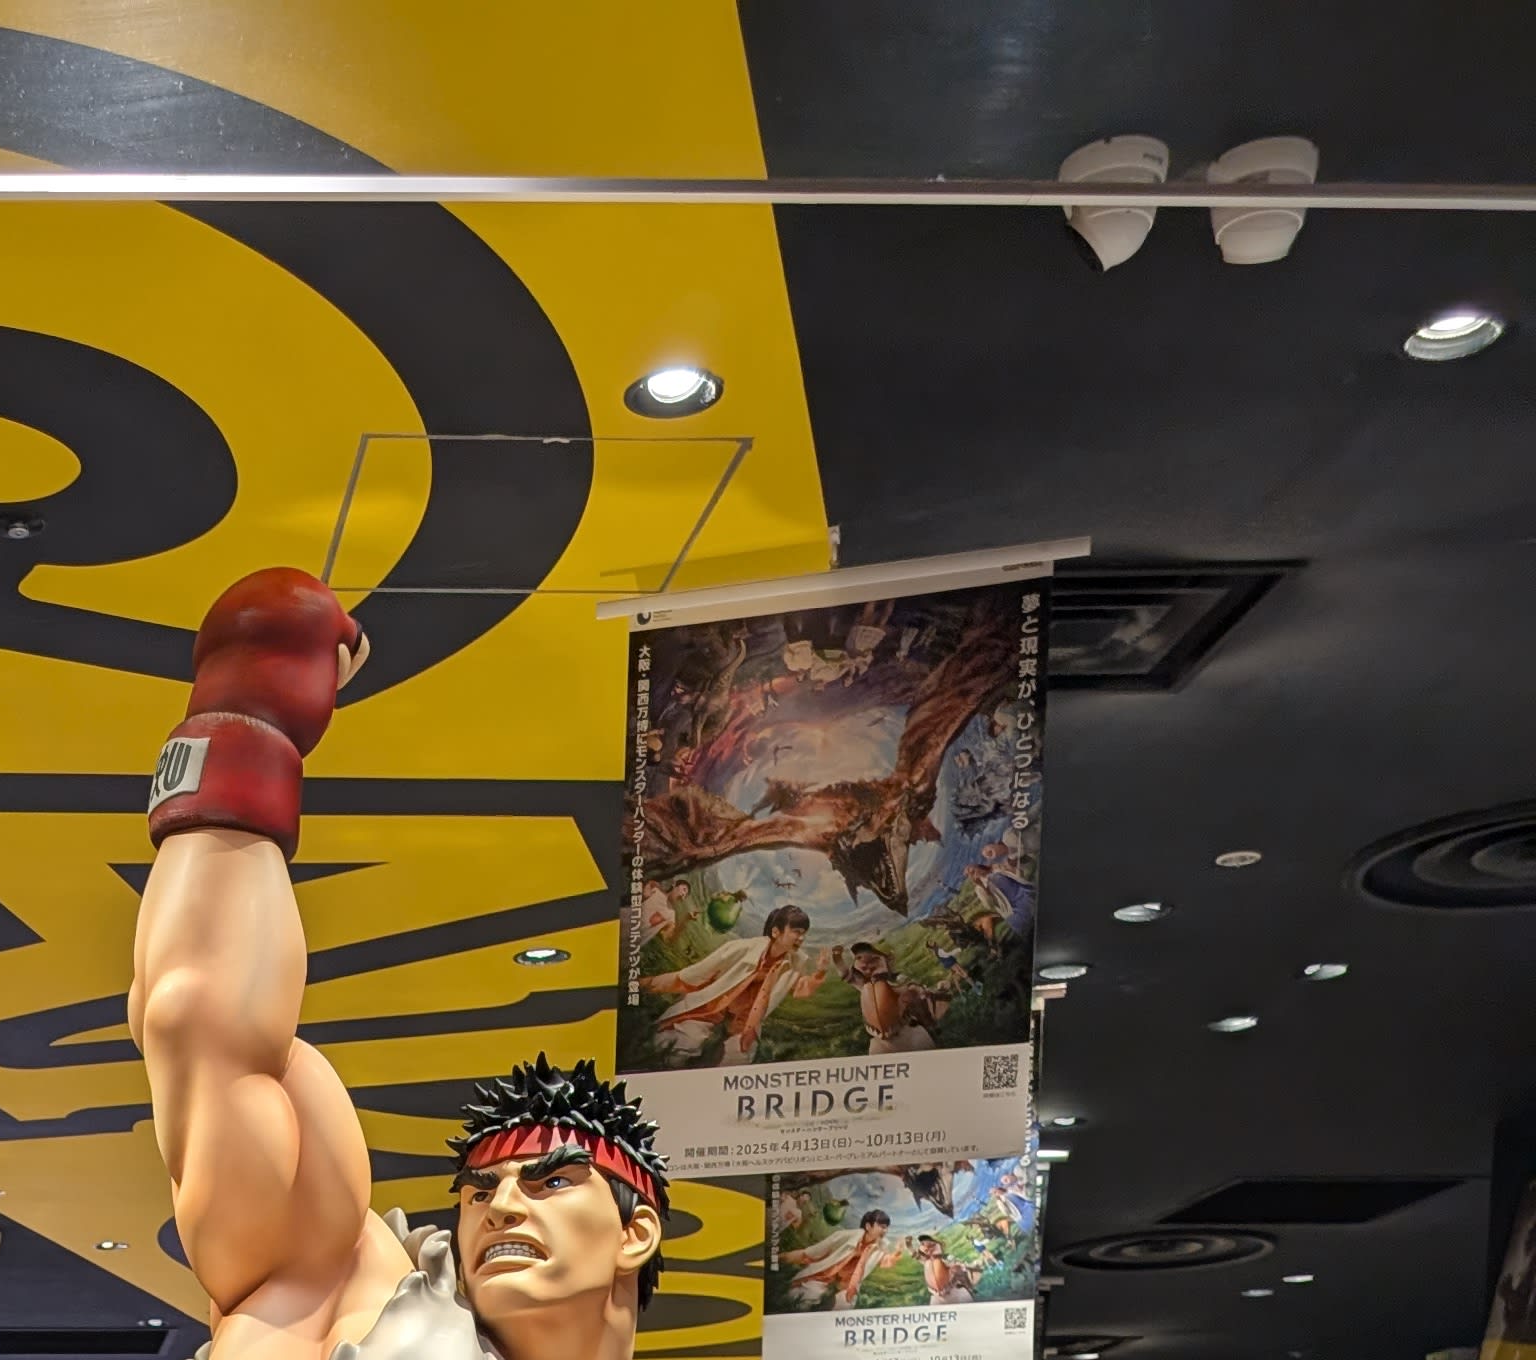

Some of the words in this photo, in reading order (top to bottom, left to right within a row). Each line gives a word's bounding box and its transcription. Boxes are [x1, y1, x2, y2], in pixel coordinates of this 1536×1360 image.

[723, 1069, 821, 1091] MONSTER
[826, 1063, 910, 1084] HUNTER
[736, 1084, 897, 1121] BRIDGE
[835, 1314, 899, 1327] MONSTER
[903, 1311, 957, 1324] HUNTER
[844, 1324, 948, 1347] BRIDGE
